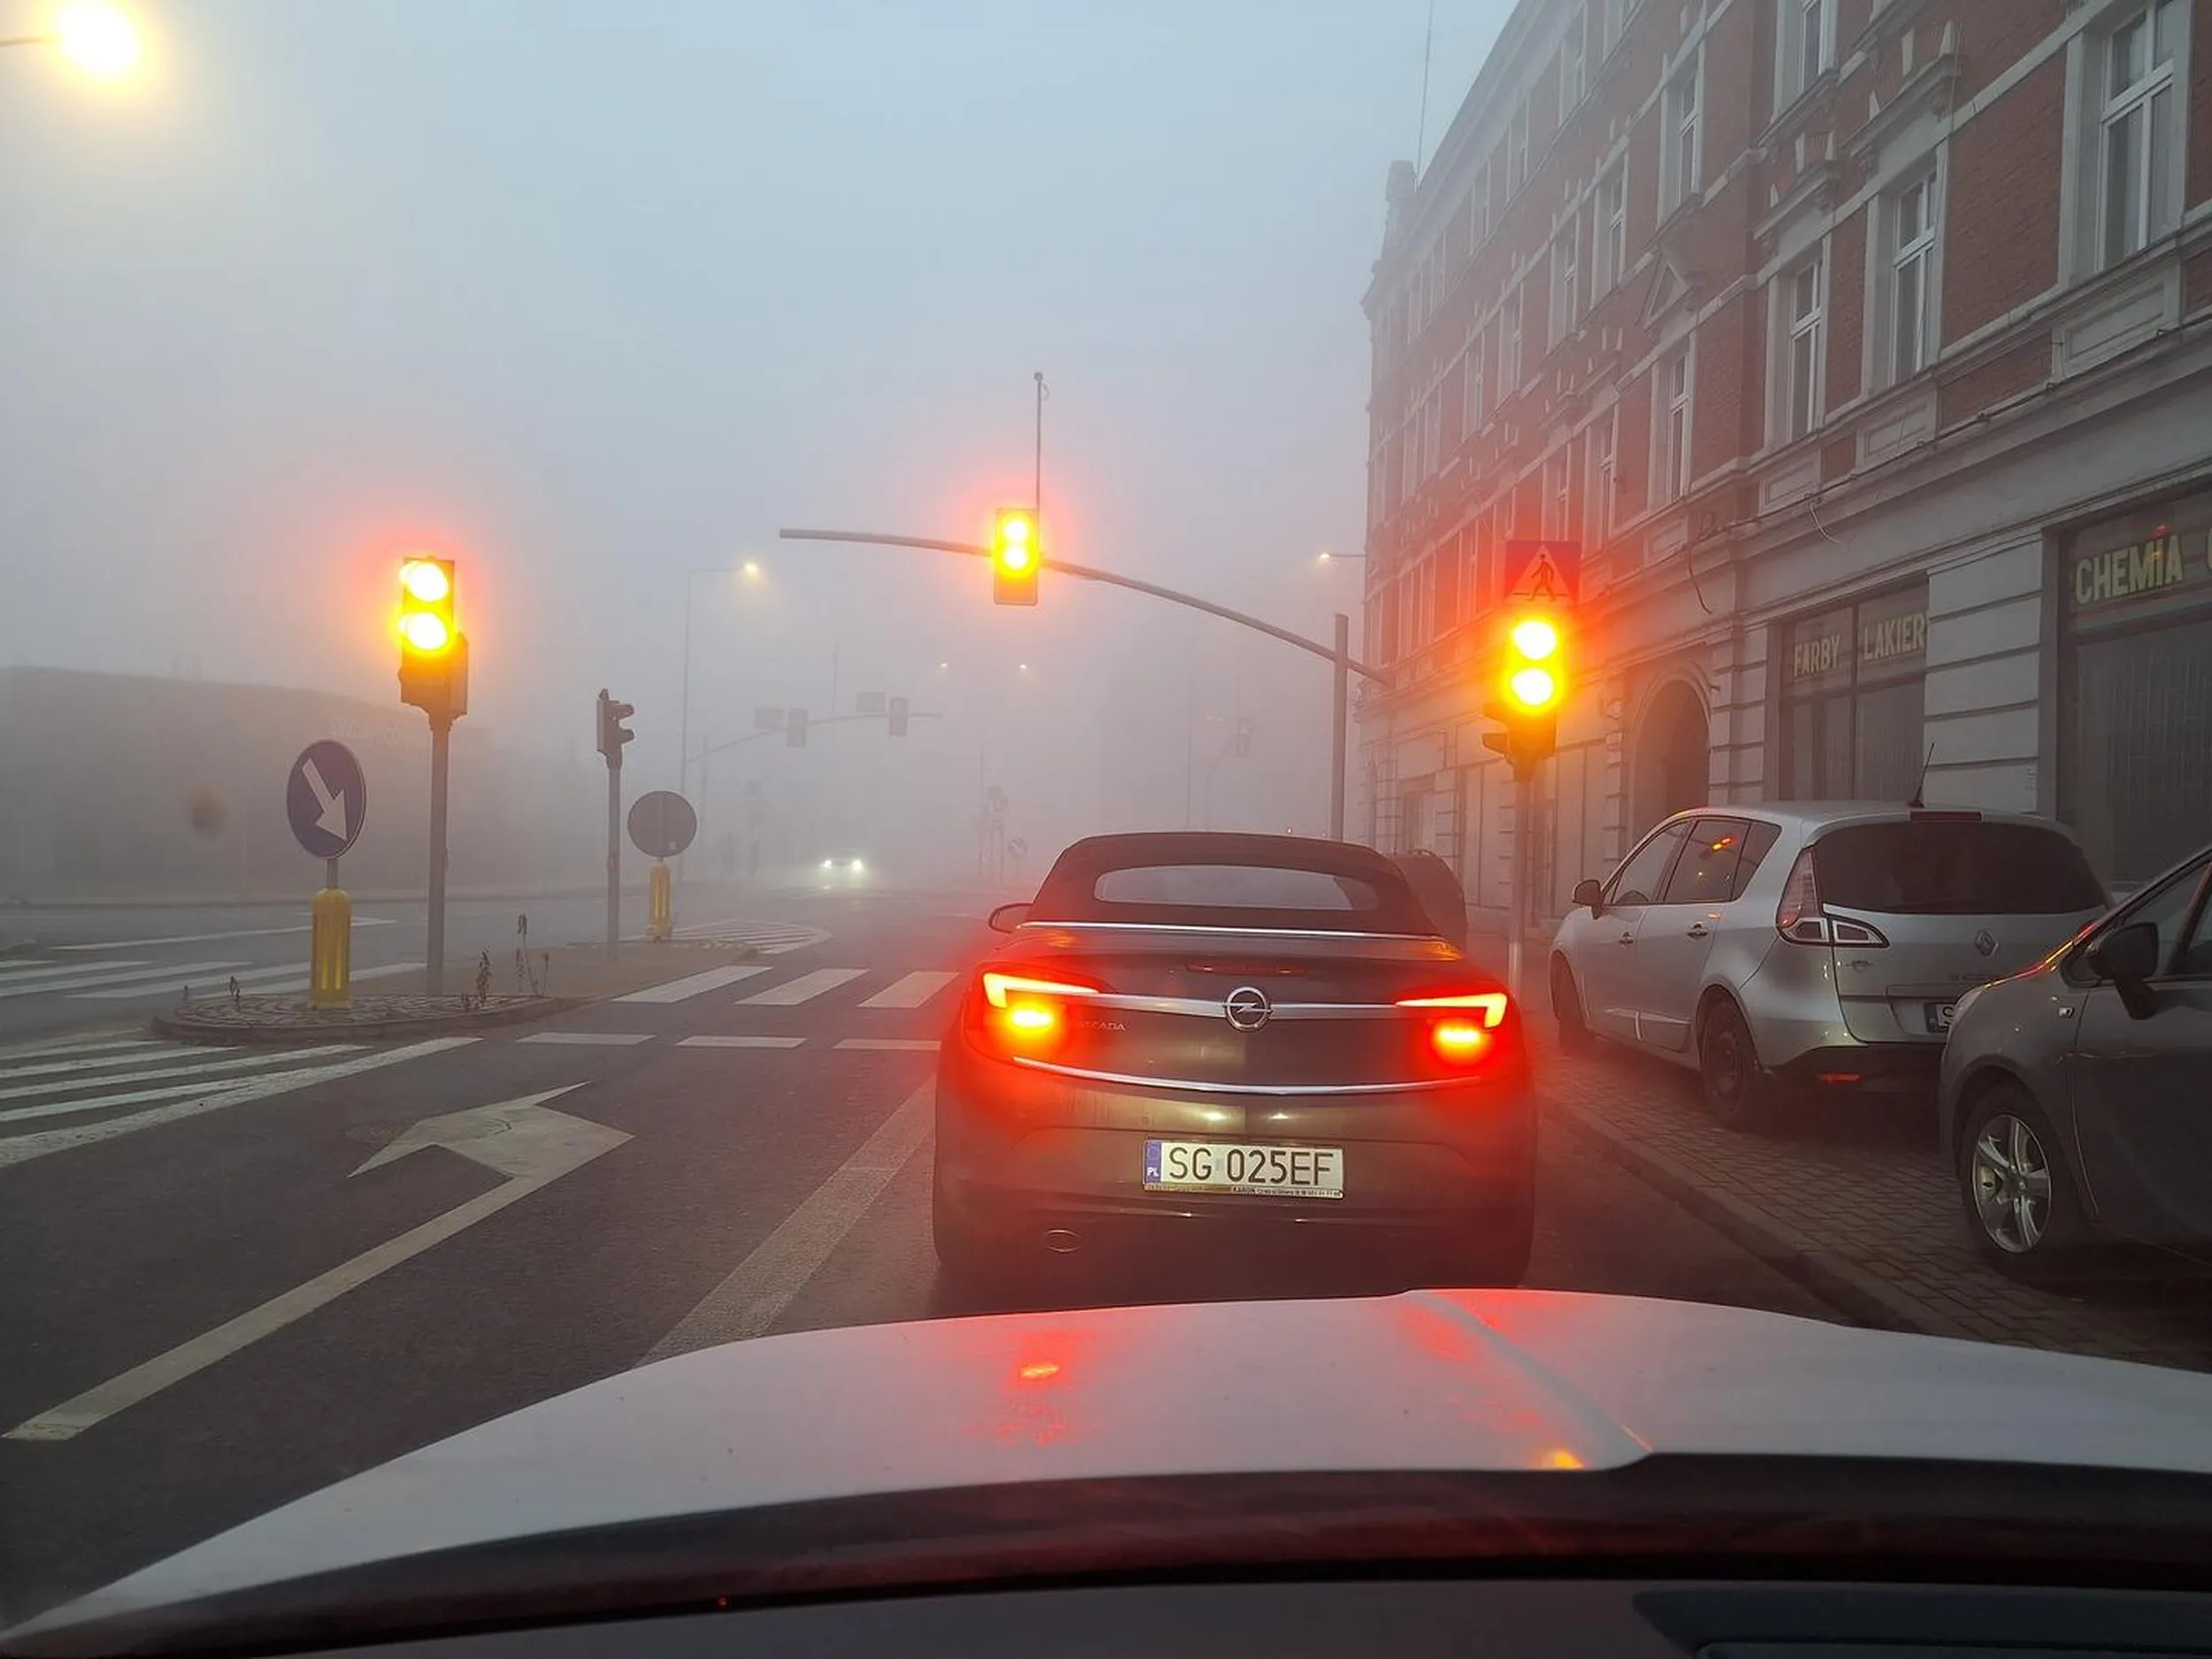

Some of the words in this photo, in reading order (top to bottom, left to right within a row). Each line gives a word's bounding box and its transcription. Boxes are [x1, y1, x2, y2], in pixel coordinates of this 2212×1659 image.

[2076, 534, 2184, 603] CHEMIA
[1793, 634, 1840, 678] FARBY
[1863, 612, 1924, 661] LAKIER
[1147, 1166, 1159, 1177] PL
[1169, 1147, 1212, 1181] SG
[1226, 1148, 1333, 1187] 025EF
